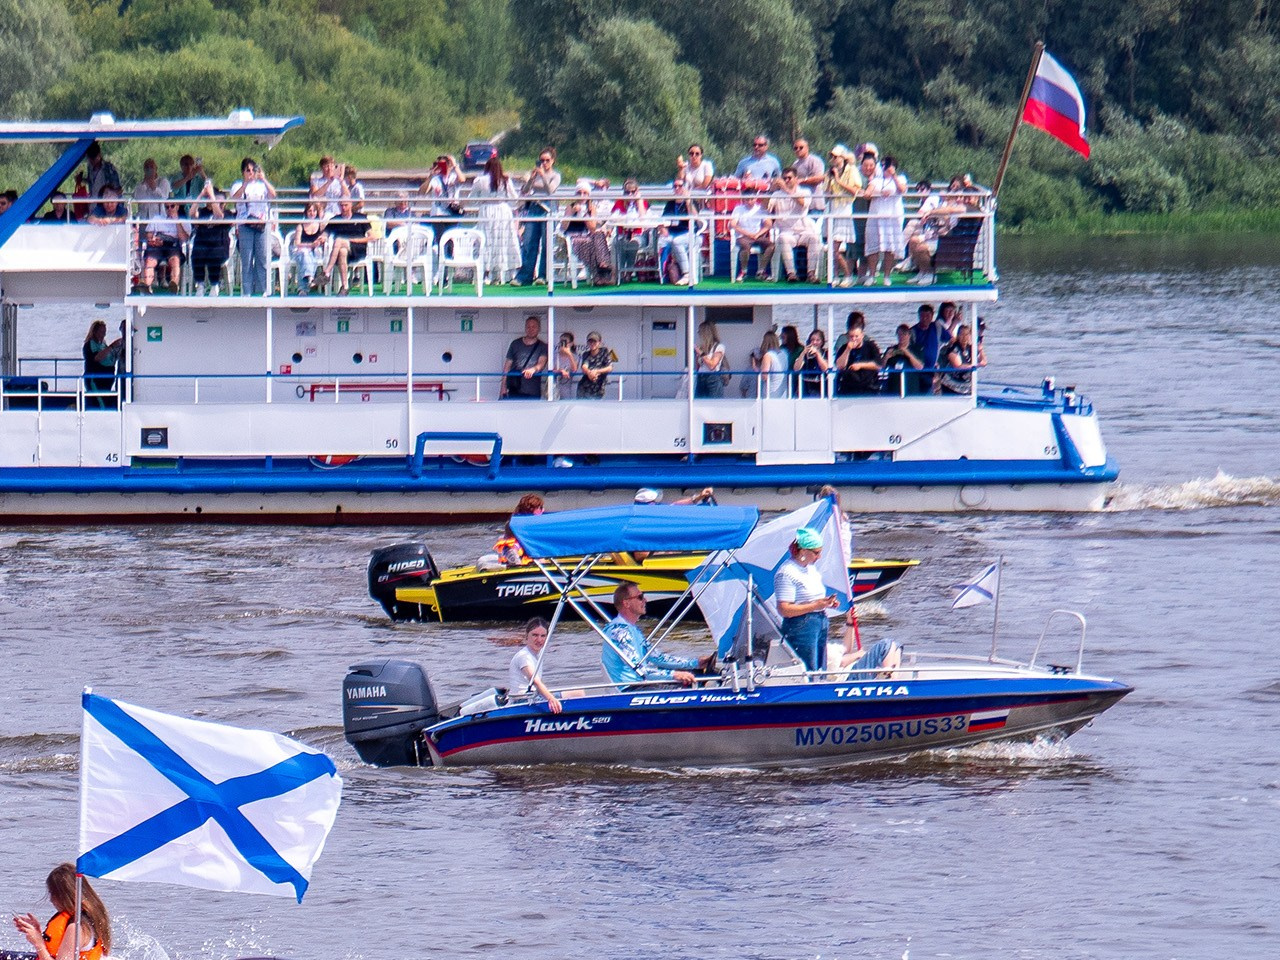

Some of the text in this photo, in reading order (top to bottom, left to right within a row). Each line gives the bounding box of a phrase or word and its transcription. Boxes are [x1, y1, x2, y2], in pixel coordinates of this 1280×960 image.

[385, 439, 398, 449] 50
[673, 437, 686, 447] 55
[888, 434, 902, 444] 60
[1044, 445, 1057, 455] 65
[105, 453, 119, 462] 45
[496, 583, 550, 598] ТРИЕРА
[346, 686, 387, 699] YAMAHA
[523, 716, 593, 733] Hawk
